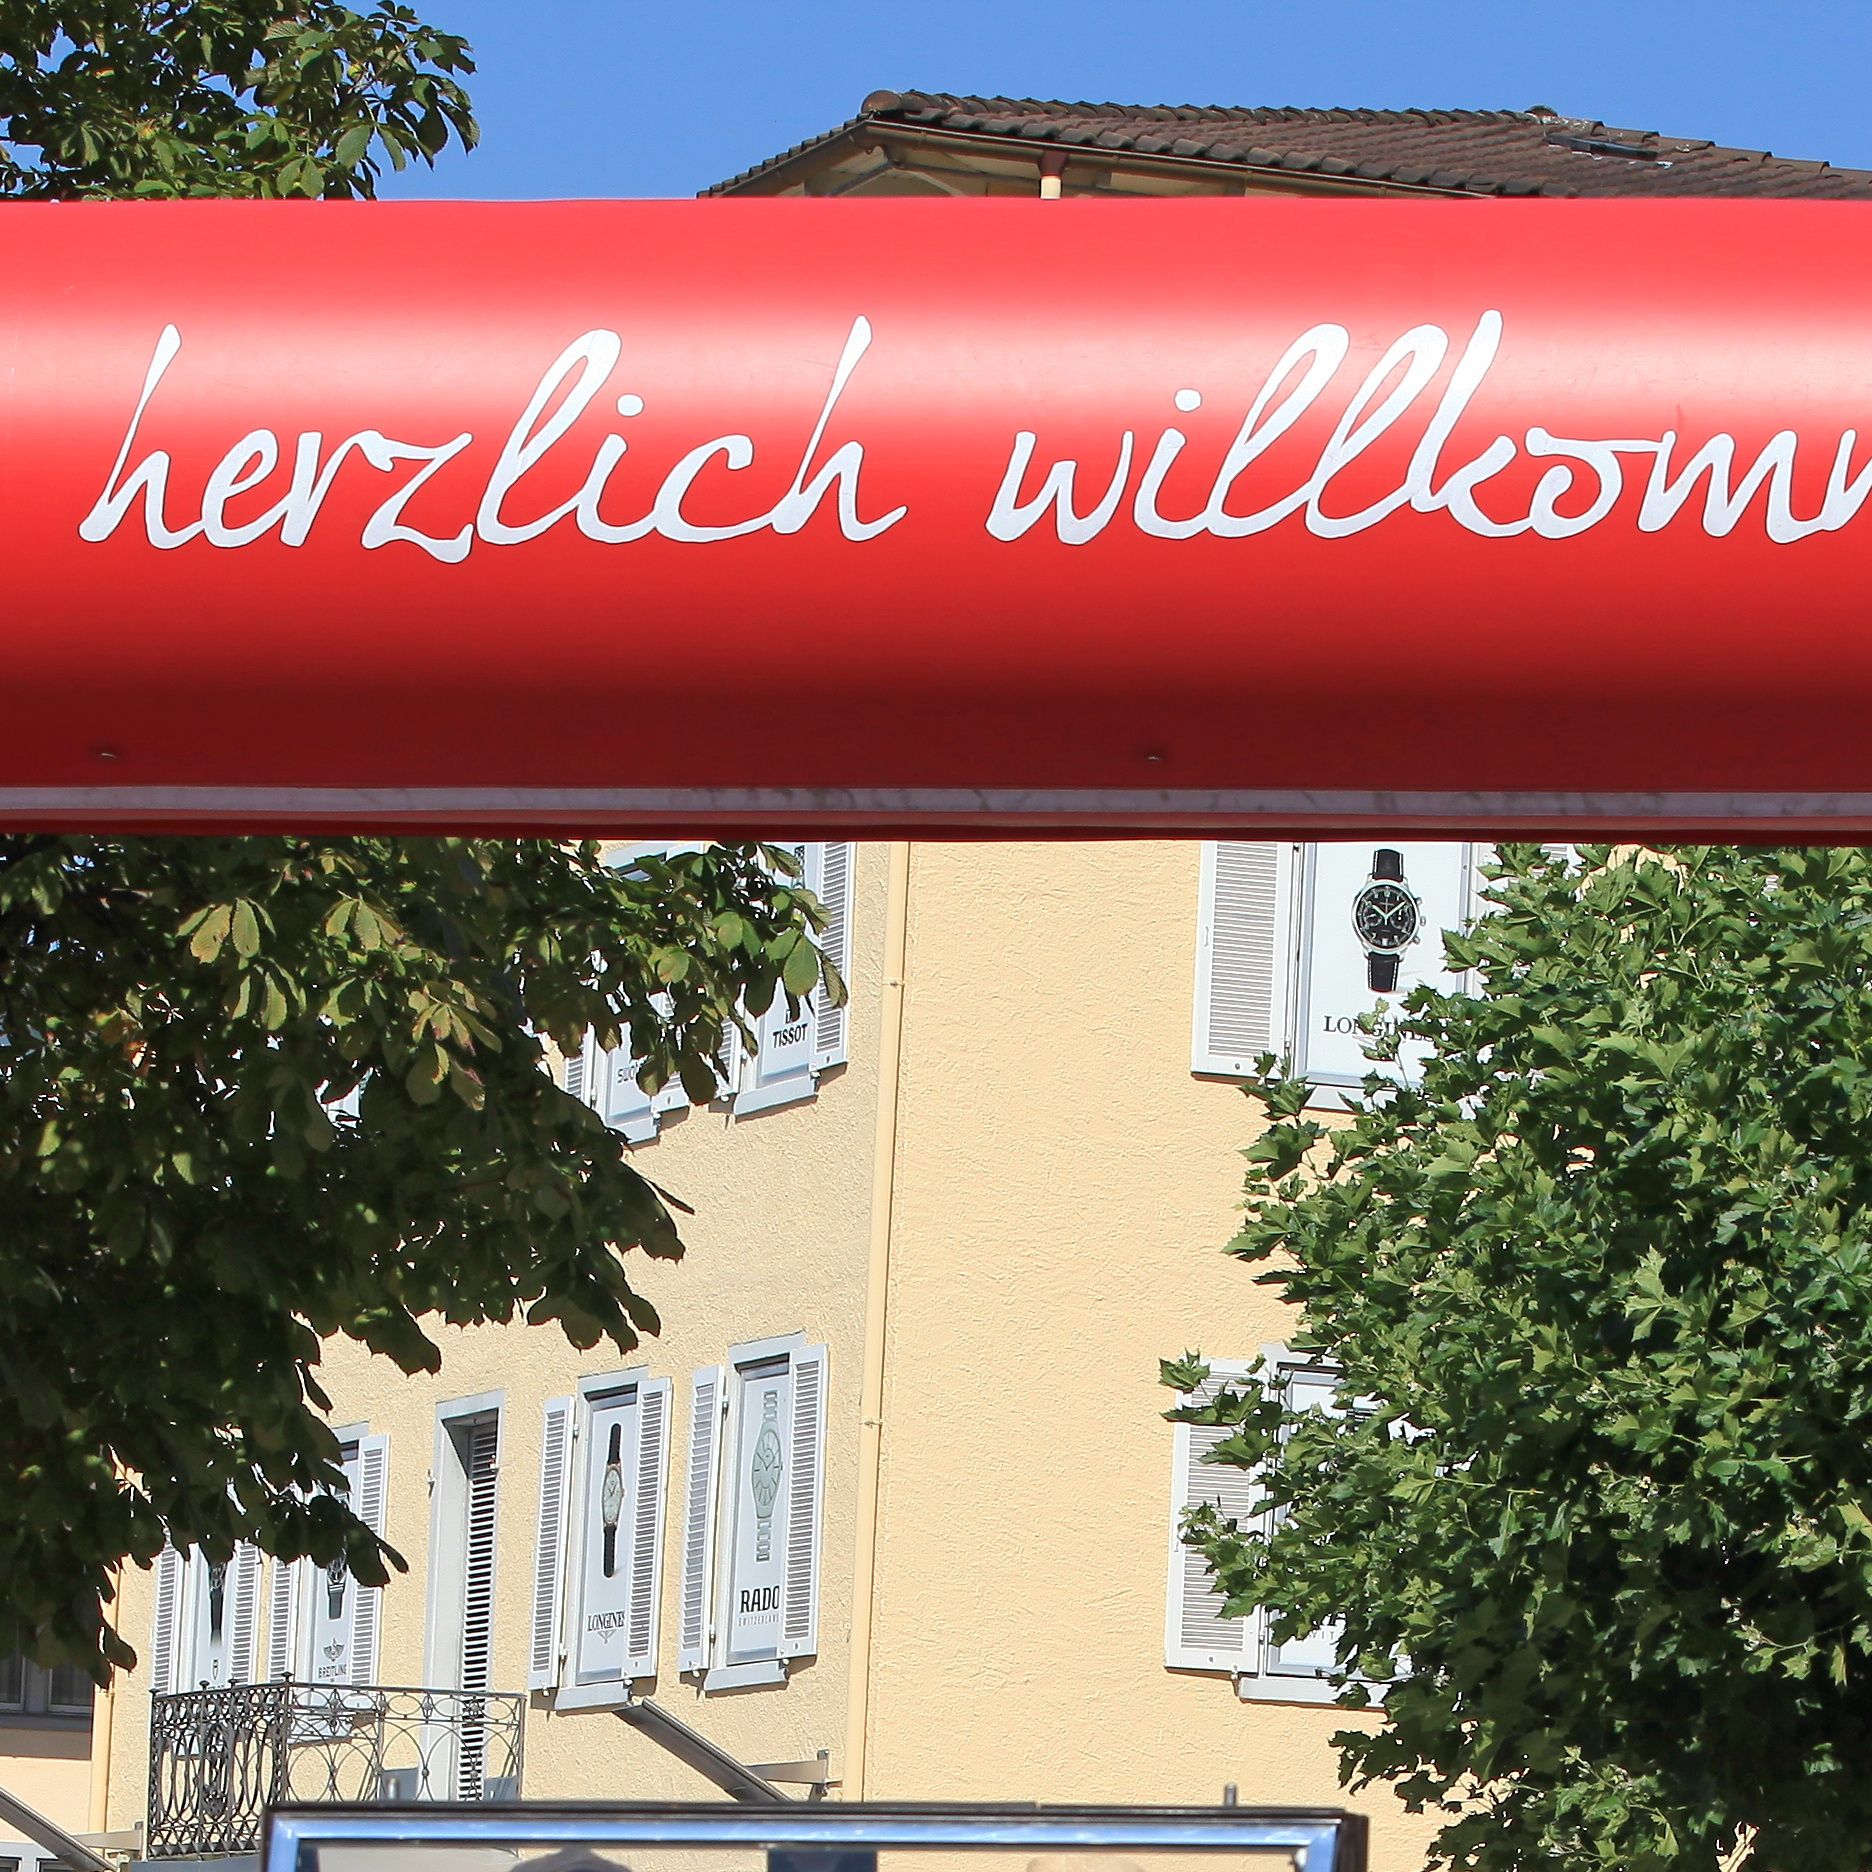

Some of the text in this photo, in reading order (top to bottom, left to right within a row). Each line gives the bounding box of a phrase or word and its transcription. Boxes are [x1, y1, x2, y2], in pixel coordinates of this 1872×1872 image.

[80, 316, 907, 562] herzlich
[772, 1023, 808, 1049] TISSOT
[739, 1585, 779, 1613] RADO
